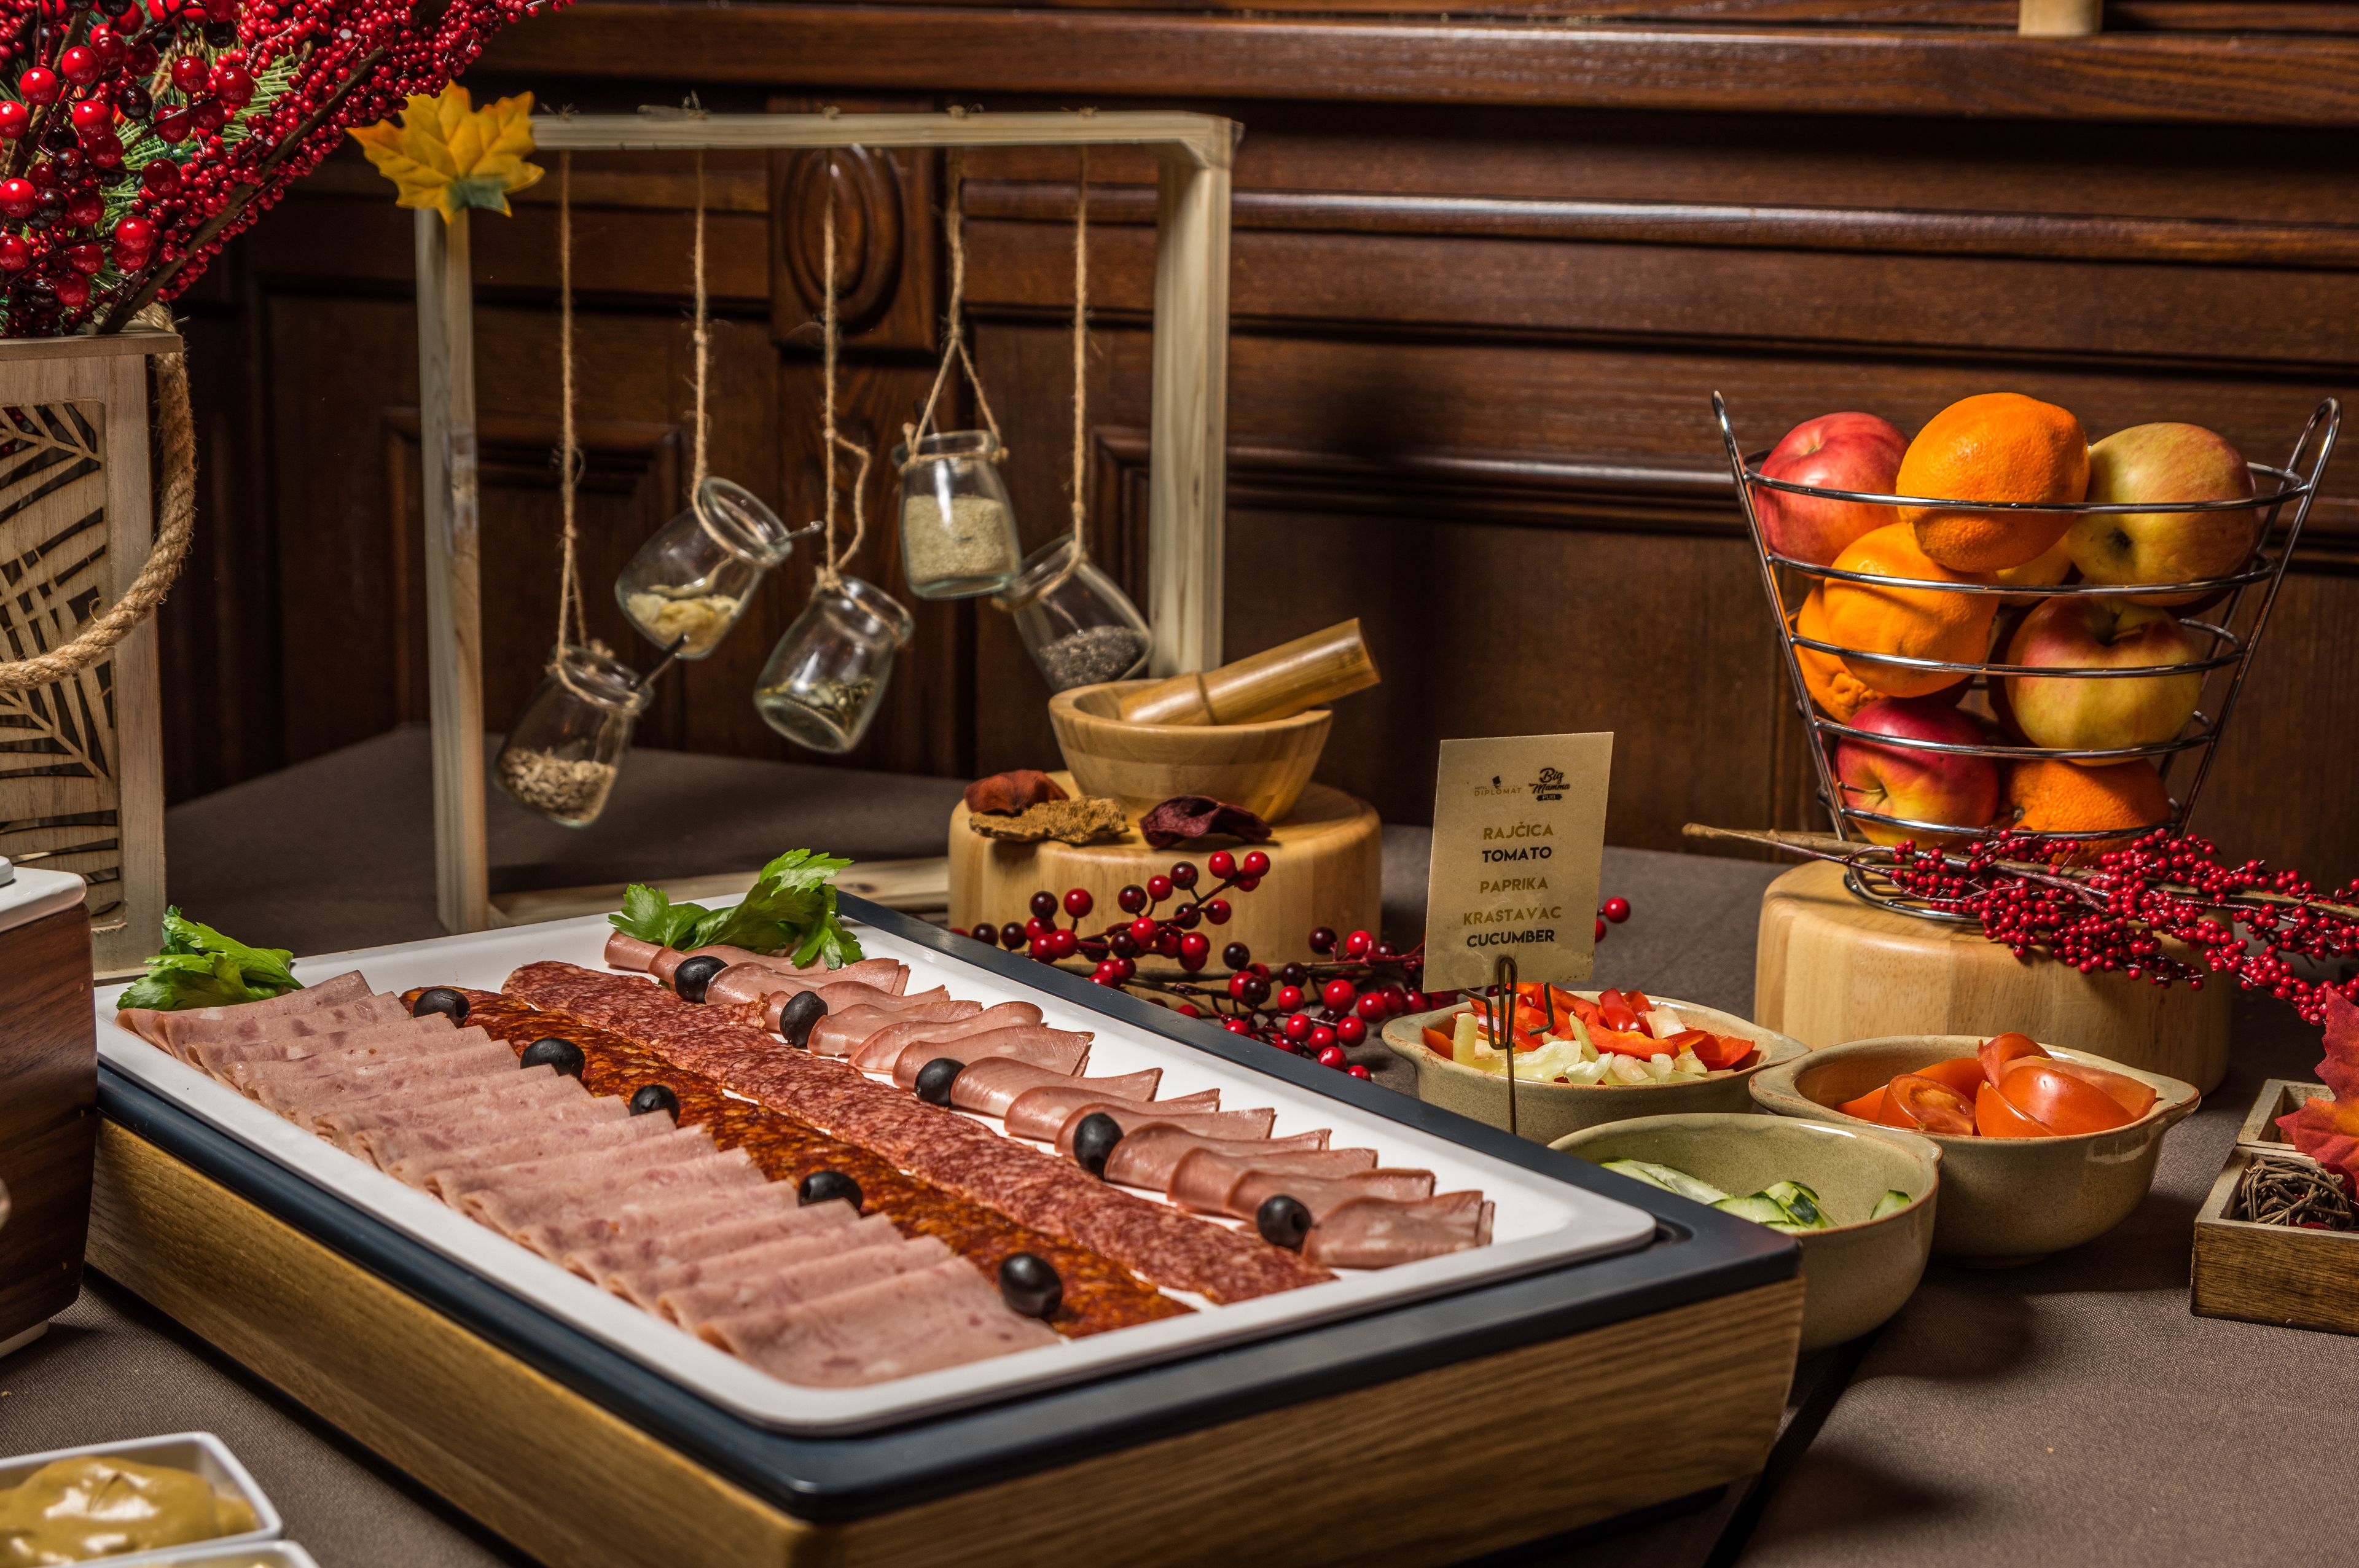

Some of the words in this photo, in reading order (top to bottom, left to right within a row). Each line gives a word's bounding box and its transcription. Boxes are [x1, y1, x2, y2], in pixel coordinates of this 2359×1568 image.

[1539, 767, 1564, 784] Big
[1474, 787, 1522, 797] DIPLOMAT
[1529, 782, 1570, 794] Mamma
[1483, 821, 1554, 840] RAJČICA
[1482, 846, 1552, 863] TOMATO
[1479, 876, 1548, 894] PAPRIKA
[1463, 905, 1562, 926] KRASTAVAC
[1466, 928, 1555, 948] CUCUMBER
